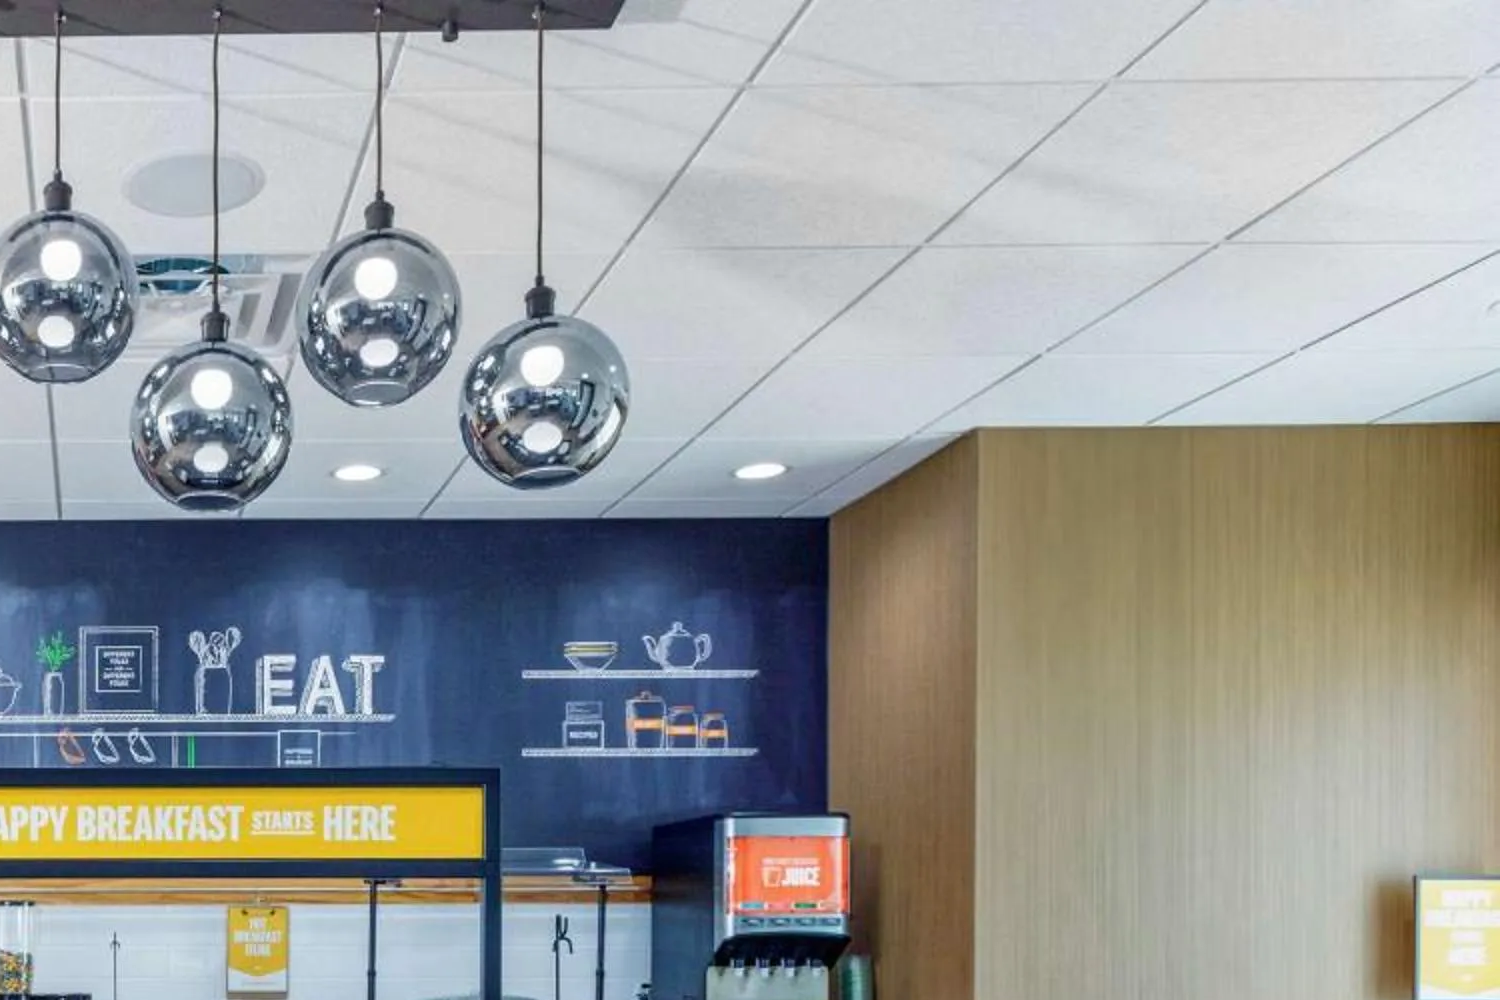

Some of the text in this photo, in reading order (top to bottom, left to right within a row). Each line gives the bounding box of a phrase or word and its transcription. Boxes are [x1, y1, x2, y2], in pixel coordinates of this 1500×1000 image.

[255, 653, 386, 716] EAT
[76, 804, 245, 842] BREAKFAST
[251, 810, 314, 830] STARTS
[323, 804, 397, 842] HERE
[781, 867, 821, 887] JUICE
